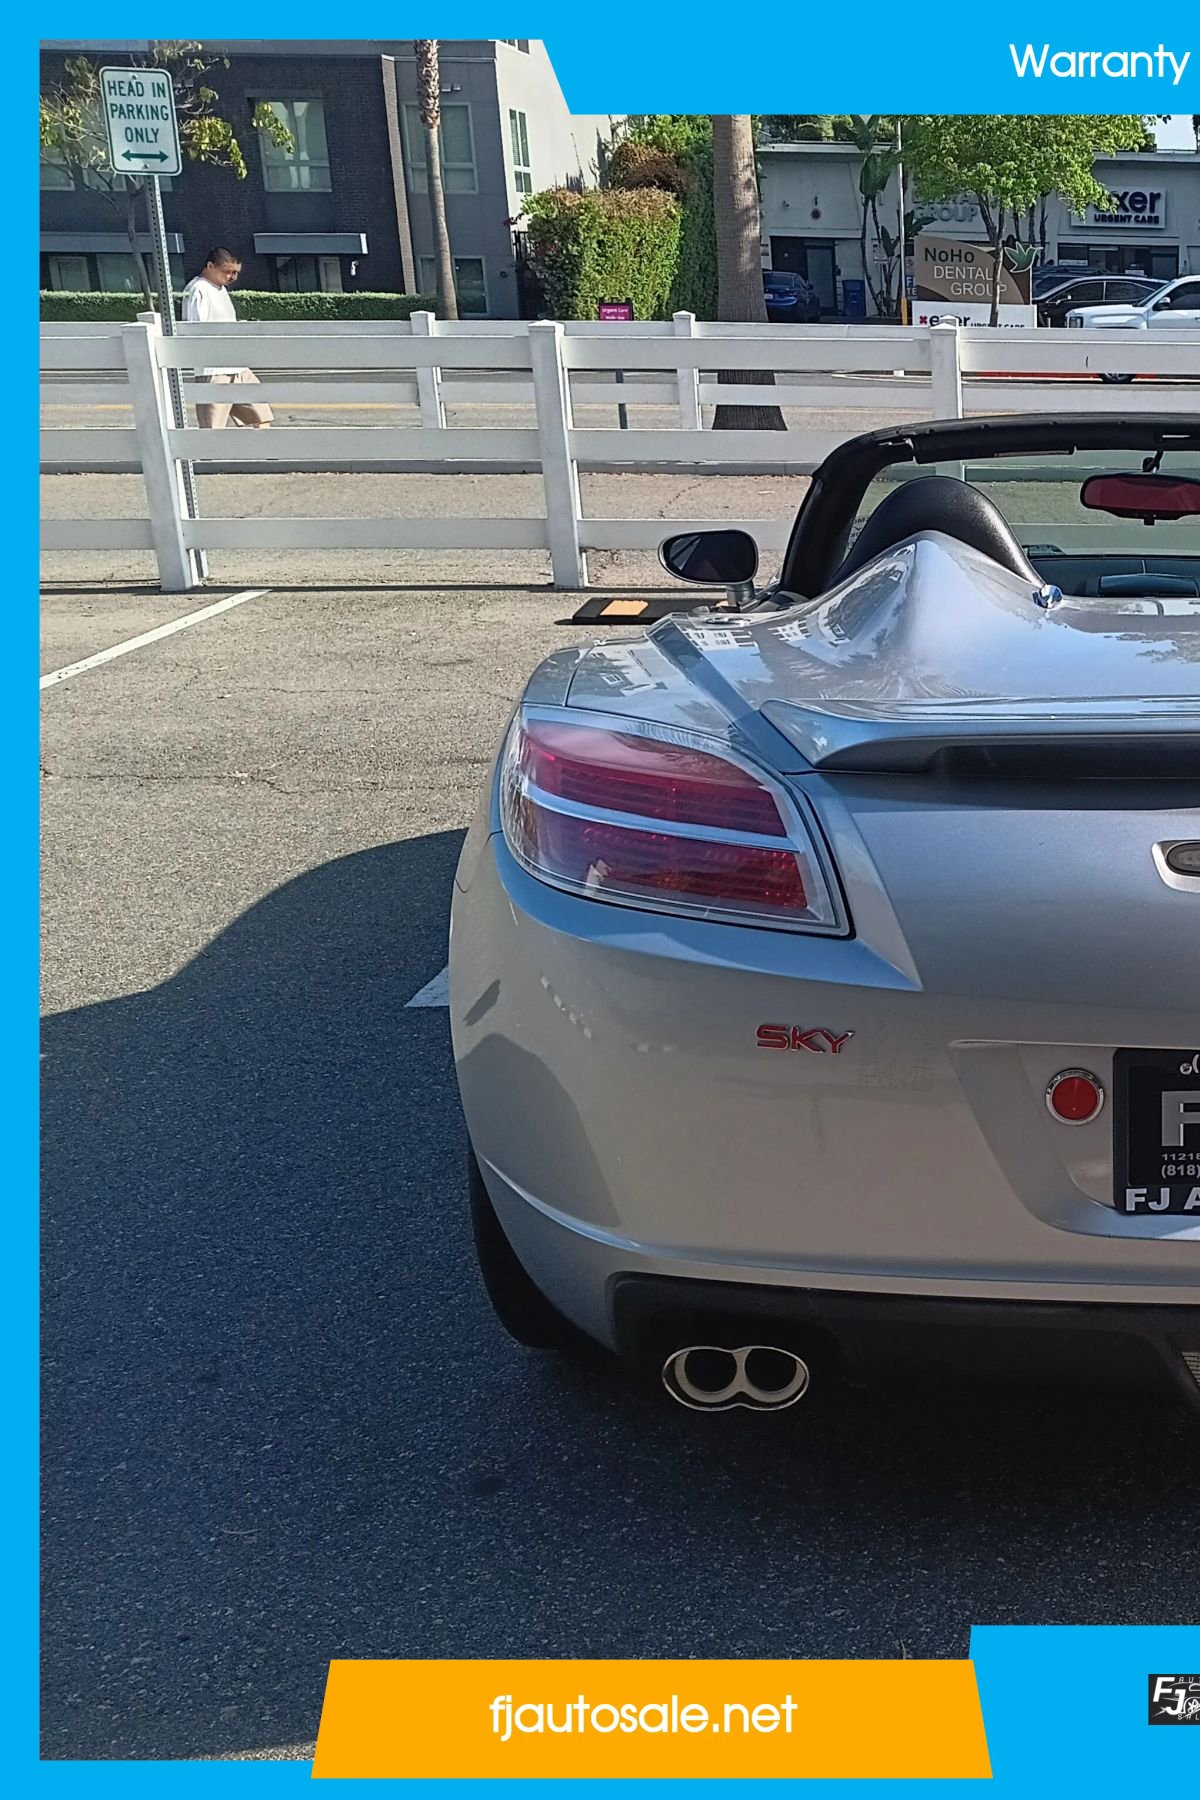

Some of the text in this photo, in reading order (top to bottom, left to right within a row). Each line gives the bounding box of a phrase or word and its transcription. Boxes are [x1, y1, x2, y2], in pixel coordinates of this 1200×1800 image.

[107, 80, 166, 98] HEAD IN
[110, 103, 169, 121] PARKING
[124, 127, 159, 143] ONLY
[1094, 190, 1162, 214] xer
[1094, 213, 1160, 225] URGENT CARE
[925, 247, 975, 264] NoHo
[934, 265, 994, 281] DENTAL
[756, 1024, 855, 1055] SKY
[1125, 1187, 1170, 1212] FJ
